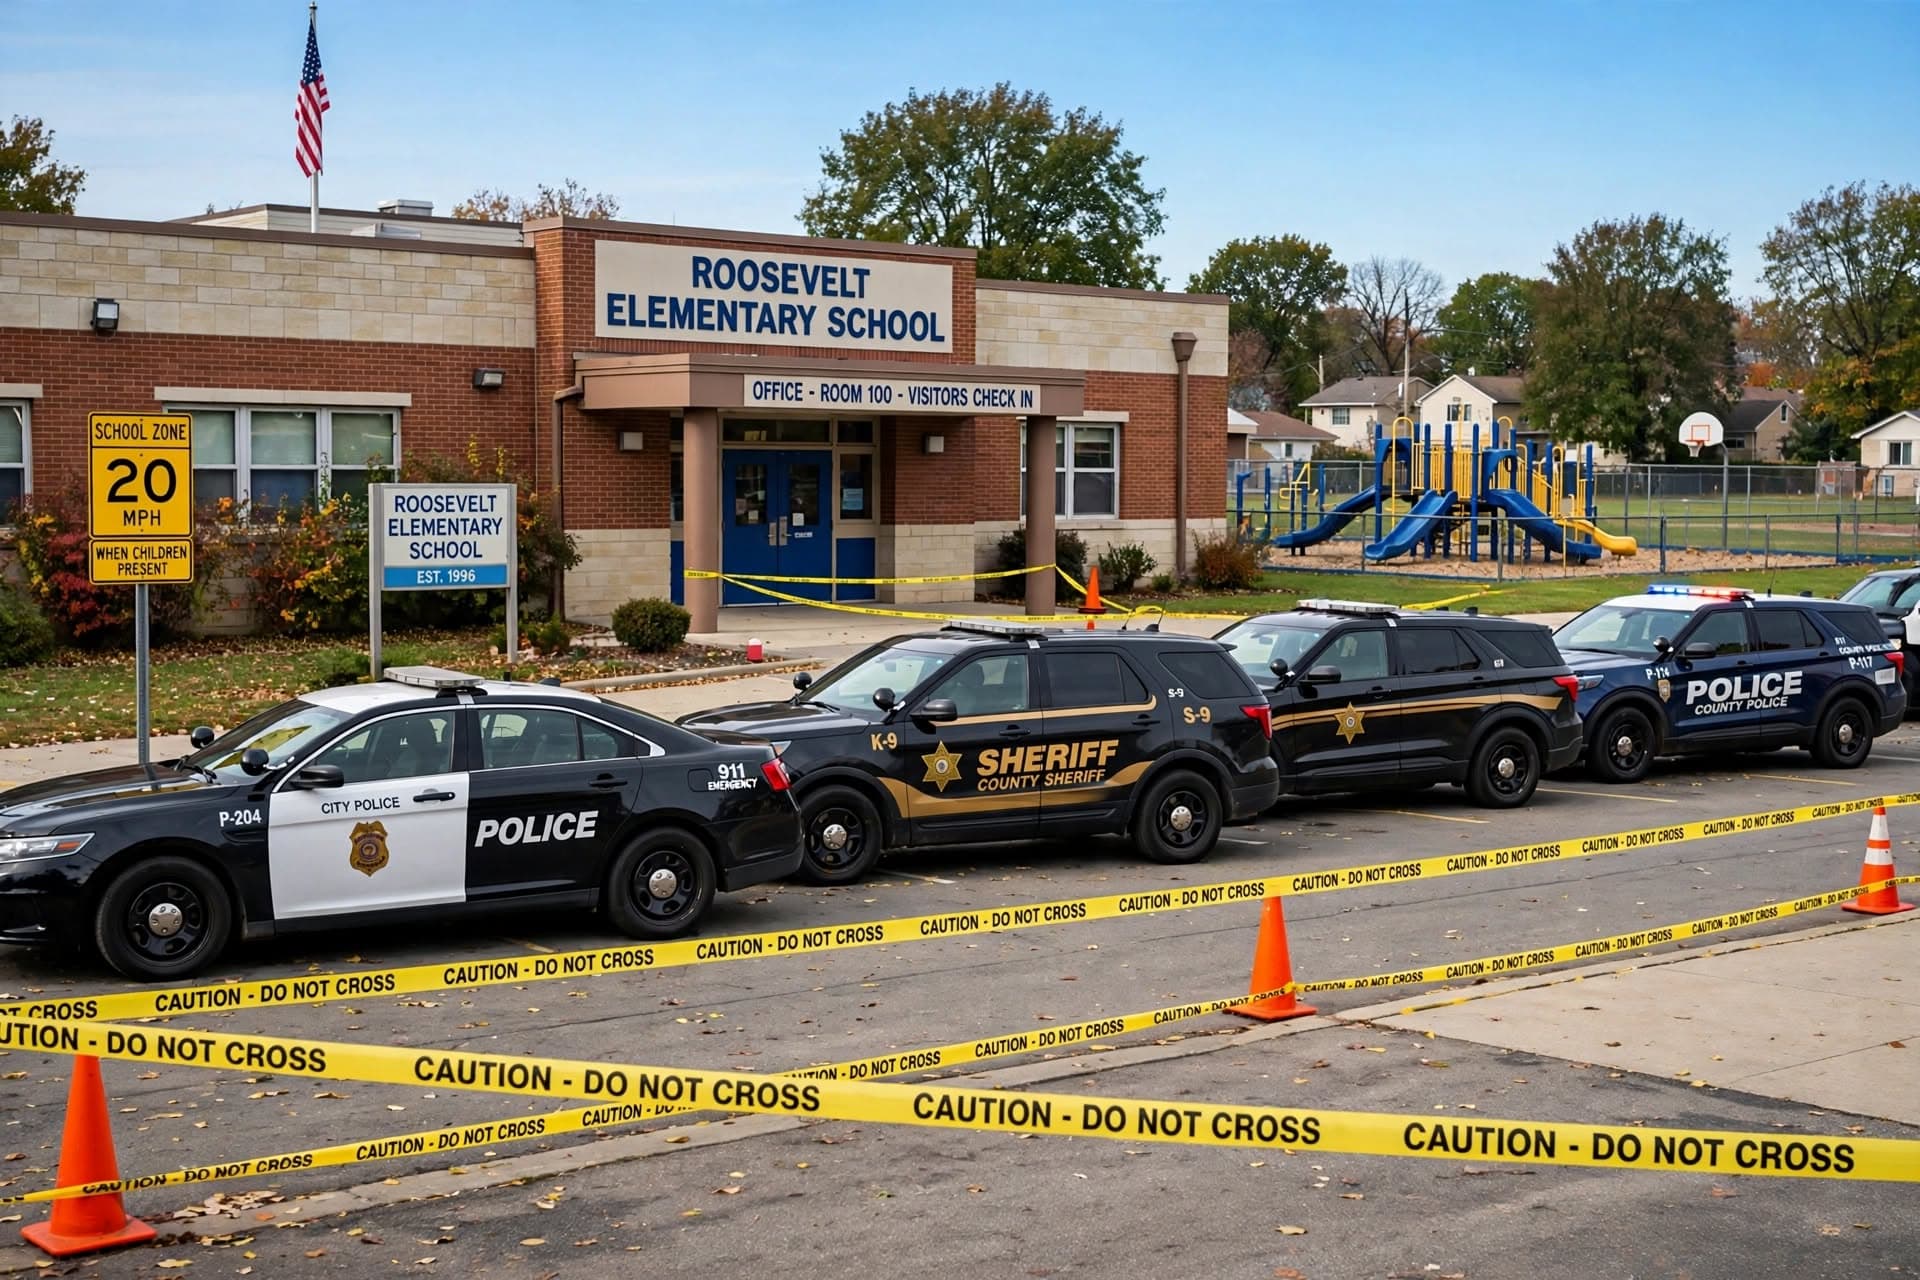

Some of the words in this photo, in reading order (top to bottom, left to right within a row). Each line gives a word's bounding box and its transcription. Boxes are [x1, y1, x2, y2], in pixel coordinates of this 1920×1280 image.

[692, 256, 870, 299] ROOSEVELT
[607, 293, 816, 336] ELEMENTARY
[827, 306, 945, 342] SCHOOL
[753, 381, 803, 401] OFFICE
[820, 383, 862, 404] ROOM
[868, 385, 892, 404] 100
[908, 386, 968, 406] VISITORS
[973, 387, 1016, 407] CHECK
[1020, 389, 1033, 408] IN
[95, 423, 147, 440] SCHOOL
[152, 423, 186, 440] ZONE
[107, 458, 177, 503] 20
[394, 495, 496, 513] ROOSEVELT
[123, 510, 161, 526] MPH
[388, 517, 503, 536] ELEMENTARY
[96, 547, 128, 560] WHEN
[133, 546, 187, 560] CHILDREN
[409, 541, 483, 559] SCHOOL
[118, 562, 168, 576] PRESENT
[417, 570, 443, 584] EST.
[447, 569, 476, 583] 1996
[1849, 656, 1873, 669] P-117
[1168, 688, 1184, 698] S-9
[1686, 670, 1803, 705] POLICE
[1183, 706, 1211, 724] S-9
[1694, 700, 1743, 715] COUNTY
[1746, 696, 1788, 710] POLICE
[870, 732, 898, 750] K-9
[977, 739, 1119, 776] SHERIFF
[707, 777, 758, 791] EMERGENCY
[718, 763, 746, 780] 911
[977, 774, 1040, 792] COUNTY
[1044, 769, 1106, 787] SHERIFF
[219, 809, 262, 827] P-204
[321, 801, 351, 814] CITY
[354, 796, 400, 811] POLICE
[475, 810, 598, 847] POLICE
[1703, 820, 1735, 835] CAUTION
[1742, 818, 1752, 829] DO
[1754, 815, 1770, 827] NOT
[1771, 811, 1794, 824] CROSS
[1582, 837, 1619, 853] CAUTION
[1626, 835, 1638, 847] DO
[1639, 832, 1656, 844] NOT
[1657, 827, 1684, 842] CROSS
[1447, 855, 1487, 871] CAUTION
[1496, 852, 1509, 865] DO
[1511, 849, 1529, 862] NOT
[1531, 845, 1561, 860] CROSS
[1293, 873, 1339, 891] CAUTION
[1348, 871, 1363, 884] DO
[1366, 868, 1386, 881] NOT
[1389, 863, 1422, 879] CROSS
[1119, 893, 1171, 912] CAUTION
[1182, 890, 1198, 905] DO
[1202, 887, 1224, 902] NOT
[1228, 882, 1264, 899] CROSS
[920, 915, 979, 935] CAUTION
[992, 912, 1010, 927] DO
[1015, 908, 1040, 924] NOT
[1044, 903, 1086, 921] CROSS
[1692, 919, 1723, 934] CAUTION
[1729, 915, 1738, 927] DO
[1740, 911, 1754, 924] NOT
[1755, 907, 1777, 921] CROSS
[697, 938, 762, 959] CAUTION
[778, 935, 798, 951] DO
[803, 931, 831, 948] NOT
[836, 925, 883, 944] CROSS
[1576, 941, 1610, 957] CAUTION
[1617, 938, 1628, 949] DO
[1630, 934, 1645, 947] NOT
[1647, 929, 1672, 944] CROSS
[444, 962, 518, 985] CAUTION
[535, 959, 558, 975] DO
[564, 955, 596, 973] NOT
[602, 949, 653, 969] CROSS
[1446, 962, 1484, 978] CAUTION
[1492, 959, 1505, 971] DO
[1506, 955, 1524, 968] NOT
[1526, 950, 1554, 966] CROSS
[1392, 971, 1423, 985] CROSS
[155, 988, 240, 1012] CAUTION
[261, 983, 287, 1001] DO
[294, 980, 329, 999] NOT
[336, 974, 395, 995] CROSS
[29, 1000, 98, 1020] CROSS
[1154, 1005, 1201, 1024] CAUTION
[976, 1036, 1027, 1057] CAUTION
[1040, 1032, 1055, 1046] DO
[1059, 1027, 1082, 1043] NOT
[1086, 1019, 1124, 1039] CROSS
[108, 1031, 146, 1057] DO
[158, 1036, 216, 1063] NOT
[225, 1042, 326, 1072] CROSS
[850, 1063, 867, 1079] DO
[871, 1058, 896, 1076] NOT
[900, 1051, 941, 1070] CROSS
[414, 1056, 552, 1091] CAUTION
[584, 1070, 628, 1096] DO
[640, 1074, 703, 1102] NOT
[712, 1080, 820, 1112] CROSS
[582, 1103, 642, 1126] CAUTION
[914, 1093, 1051, 1128] CAUTION
[1083, 1104, 1126, 1132] DO
[1138, 1108, 1201, 1137] NOT
[1212, 1112, 1321, 1144] CROSS
[356, 1137, 424, 1160] CAUTION
[438, 1132, 459, 1149] DO
[464, 1127, 493, 1145] NOT
[498, 1119, 544, 1139] CROSS
[1404, 1123, 1555, 1158] CAUTION
[1593, 1133, 1641, 1162] DO
[1654, 1136, 1724, 1166] NOT
[1736, 1140, 1855, 1173] CROSS
[184, 1169, 210, 1182] DO
[215, 1162, 251, 1178] NOT
[256, 1154, 313, 1173] CROSS
